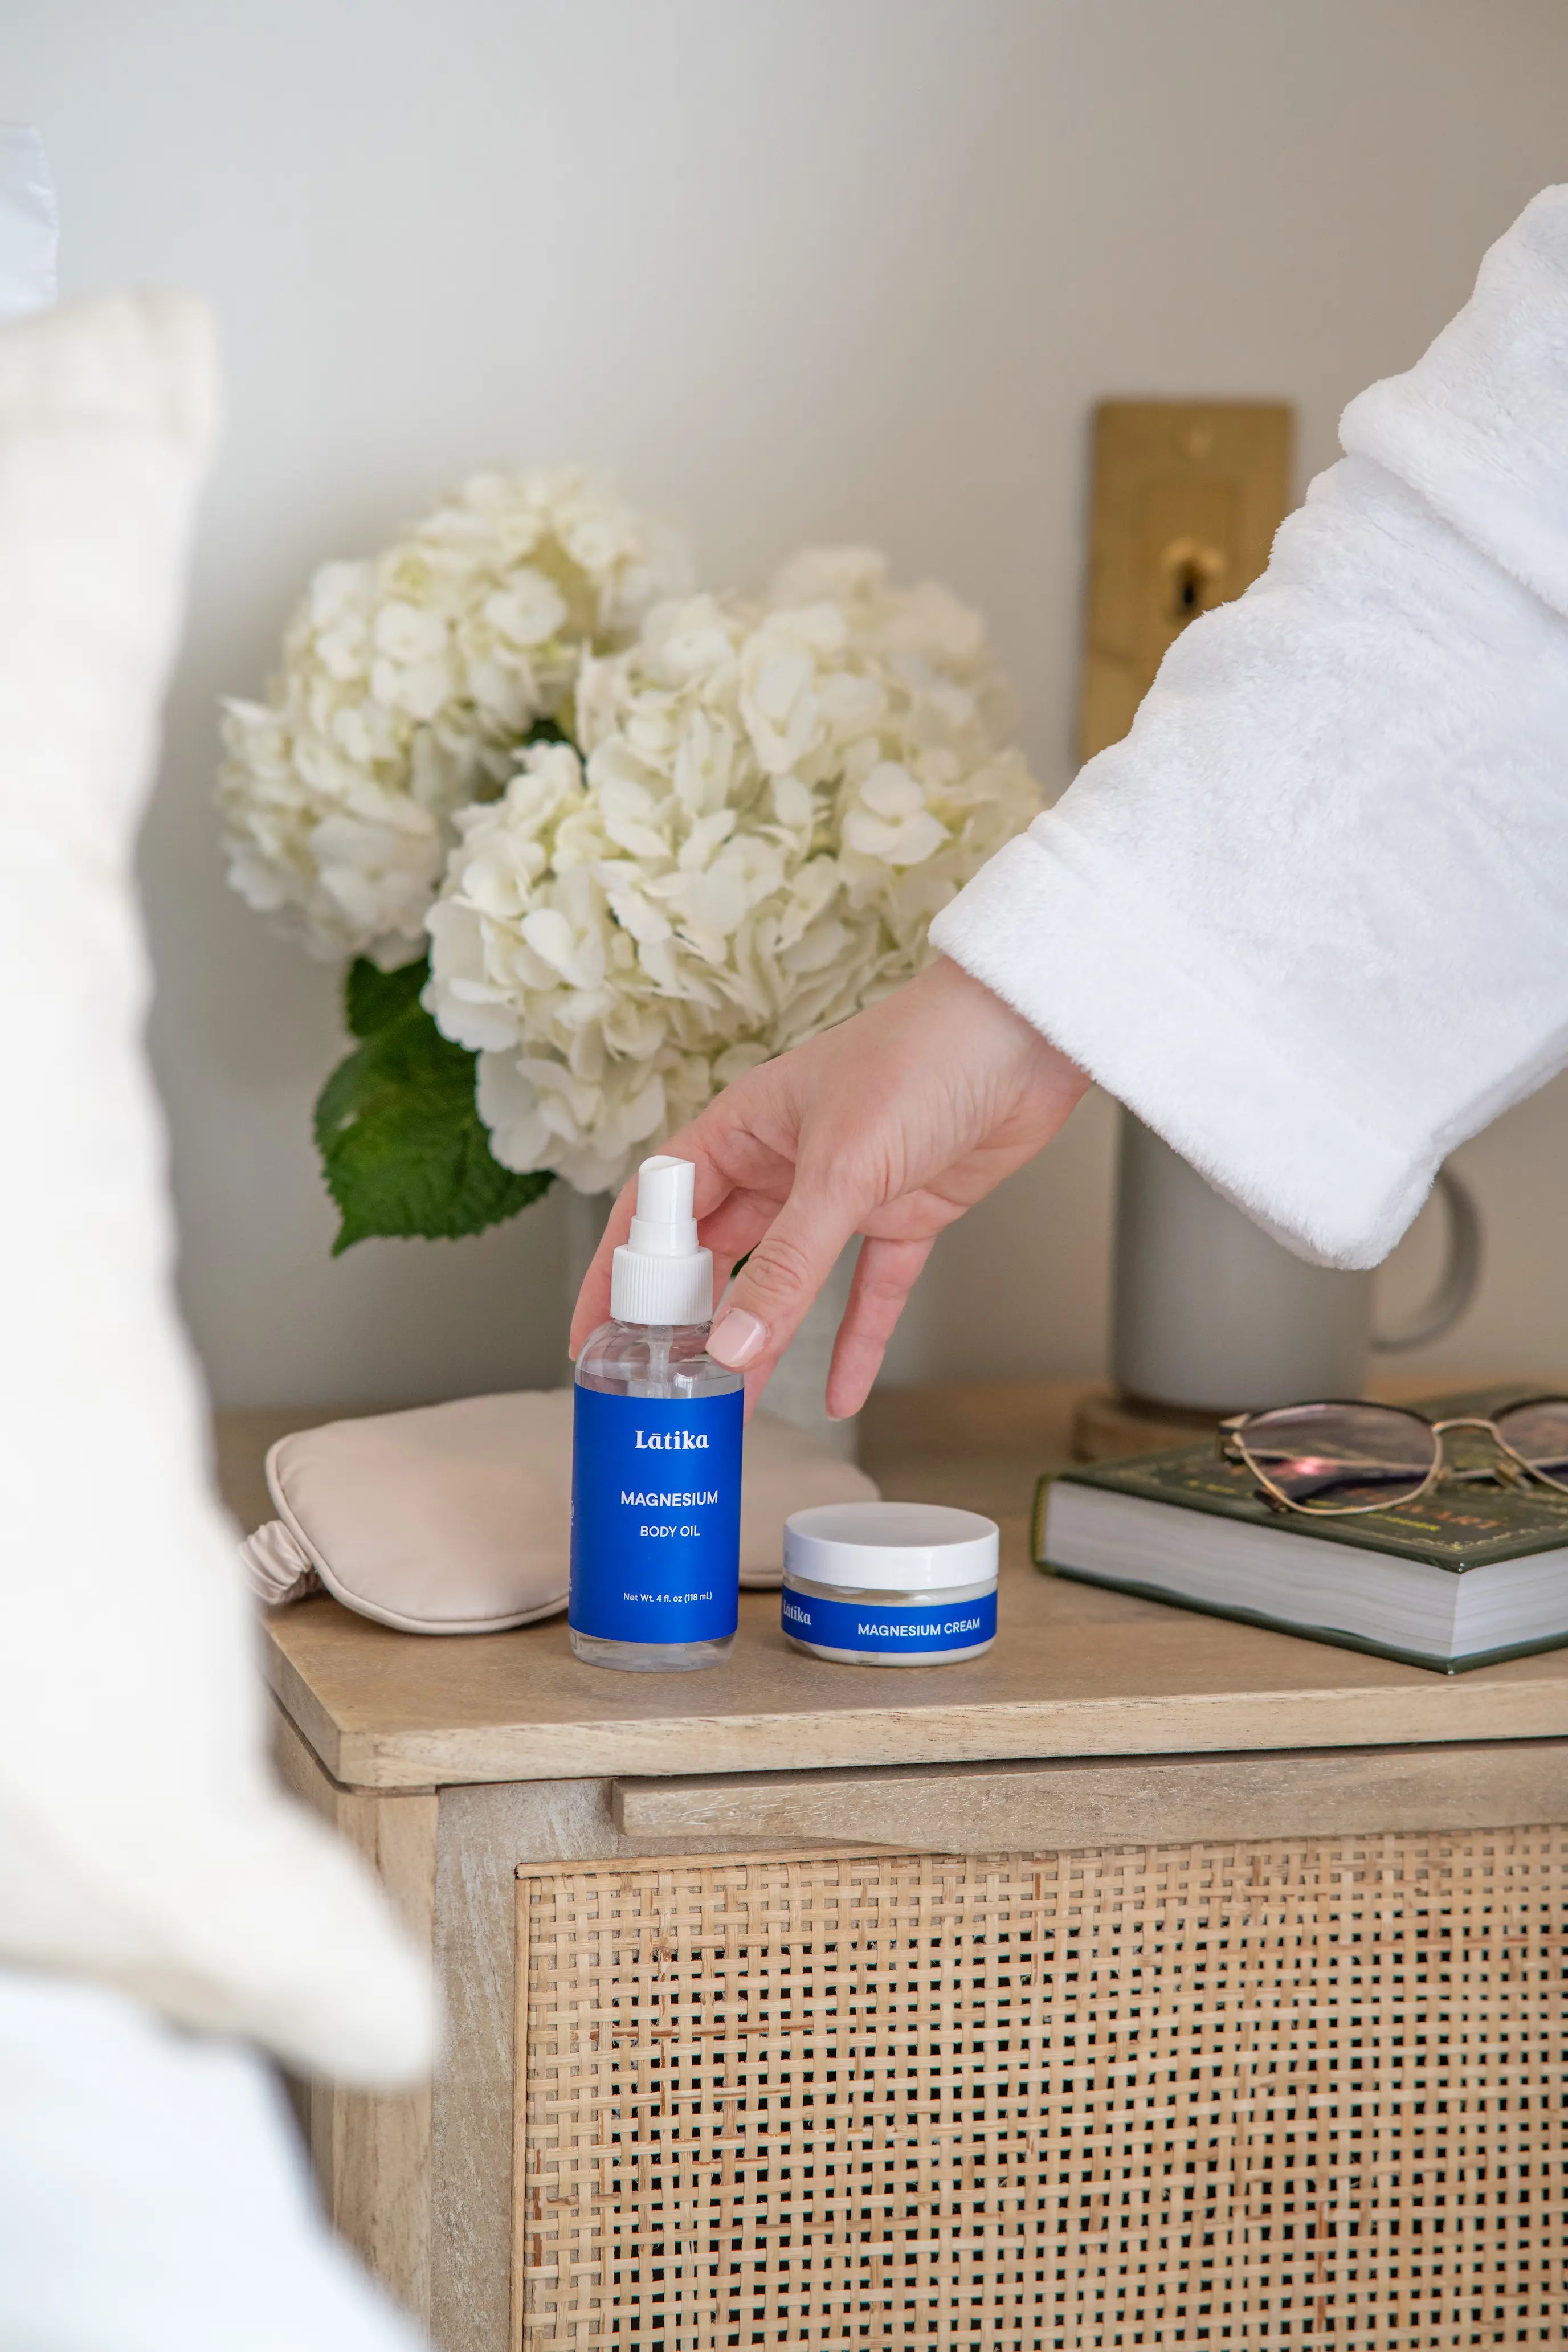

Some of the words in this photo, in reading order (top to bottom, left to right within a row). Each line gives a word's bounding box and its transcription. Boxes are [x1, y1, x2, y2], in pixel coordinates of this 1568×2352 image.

[634, 1430, 710, 1450] Lātika
[620, 1490, 718, 1507] MAGNESIUM
[640, 1525, 677, 1537] BODY
[680, 1525, 701, 1537] OIL
[623, 1592, 639, 1602] Net
[640, 1594, 655, 1602] Wt.
[684, 1593, 698, 1603] (118
[699, 1591, 712, 1601] mL)
[858, 1623, 941, 1636] MAGNESIUM
[944, 1617, 980, 1634] CREAM
